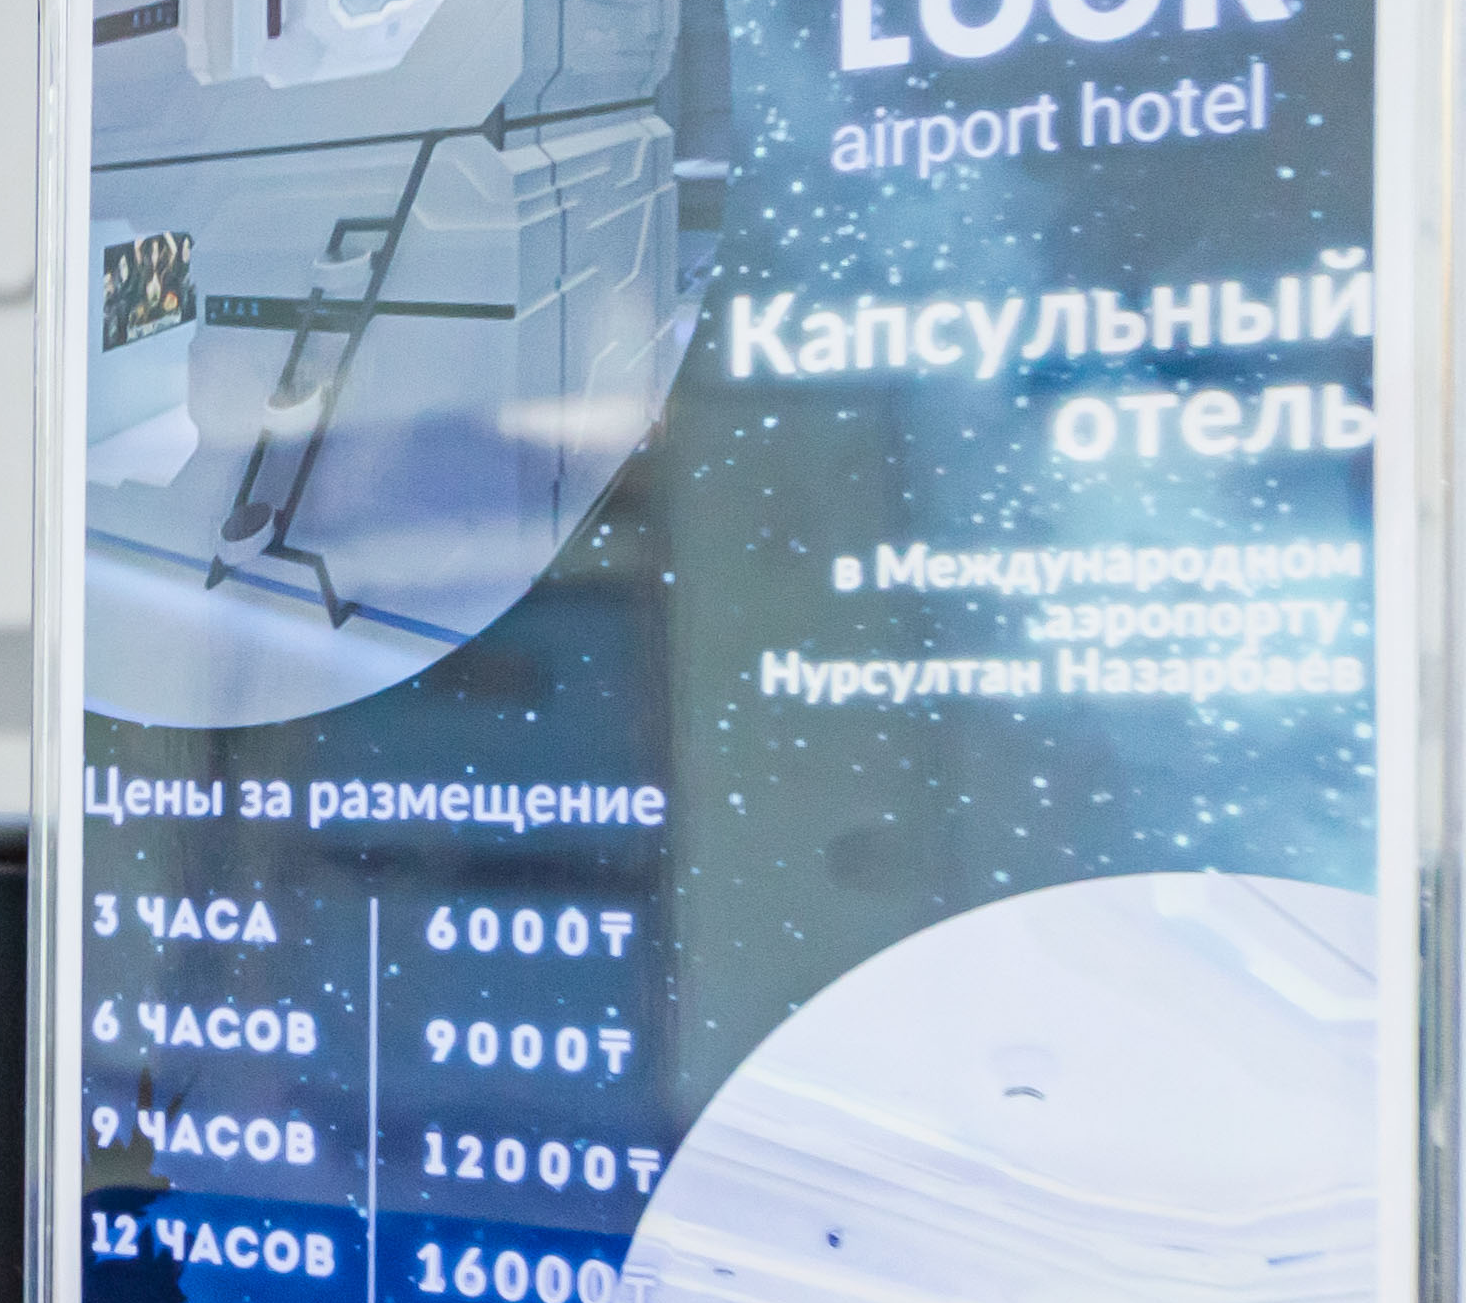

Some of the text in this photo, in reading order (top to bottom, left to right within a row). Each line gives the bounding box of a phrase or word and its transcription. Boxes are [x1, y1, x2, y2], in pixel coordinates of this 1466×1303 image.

[830, 61, 1266, 179] airport hotel
[729, 248, 1373, 379] Капсульный
[1052, 383, 1376, 461] отель
[834, 540, 1361, 594] в Международном
[1041, 600, 1346, 648] аэропорту
[761, 647, 1362, 704] Нурсултан Назарбаев
[84, 766, 666, 834] Цены за размещение
[93, 894, 117, 937] 3
[136, 896, 277, 943] ЧАСА
[93, 1000, 118, 1042] 6
[136, 1002, 317, 1055] ЧАСОВ
[92, 1106, 118, 1149] 9
[137, 1109, 316, 1165] ЧАСОВ
[92, 1212, 138, 1256] 12
[156, 1218, 336, 1277] ЧАСОВ
